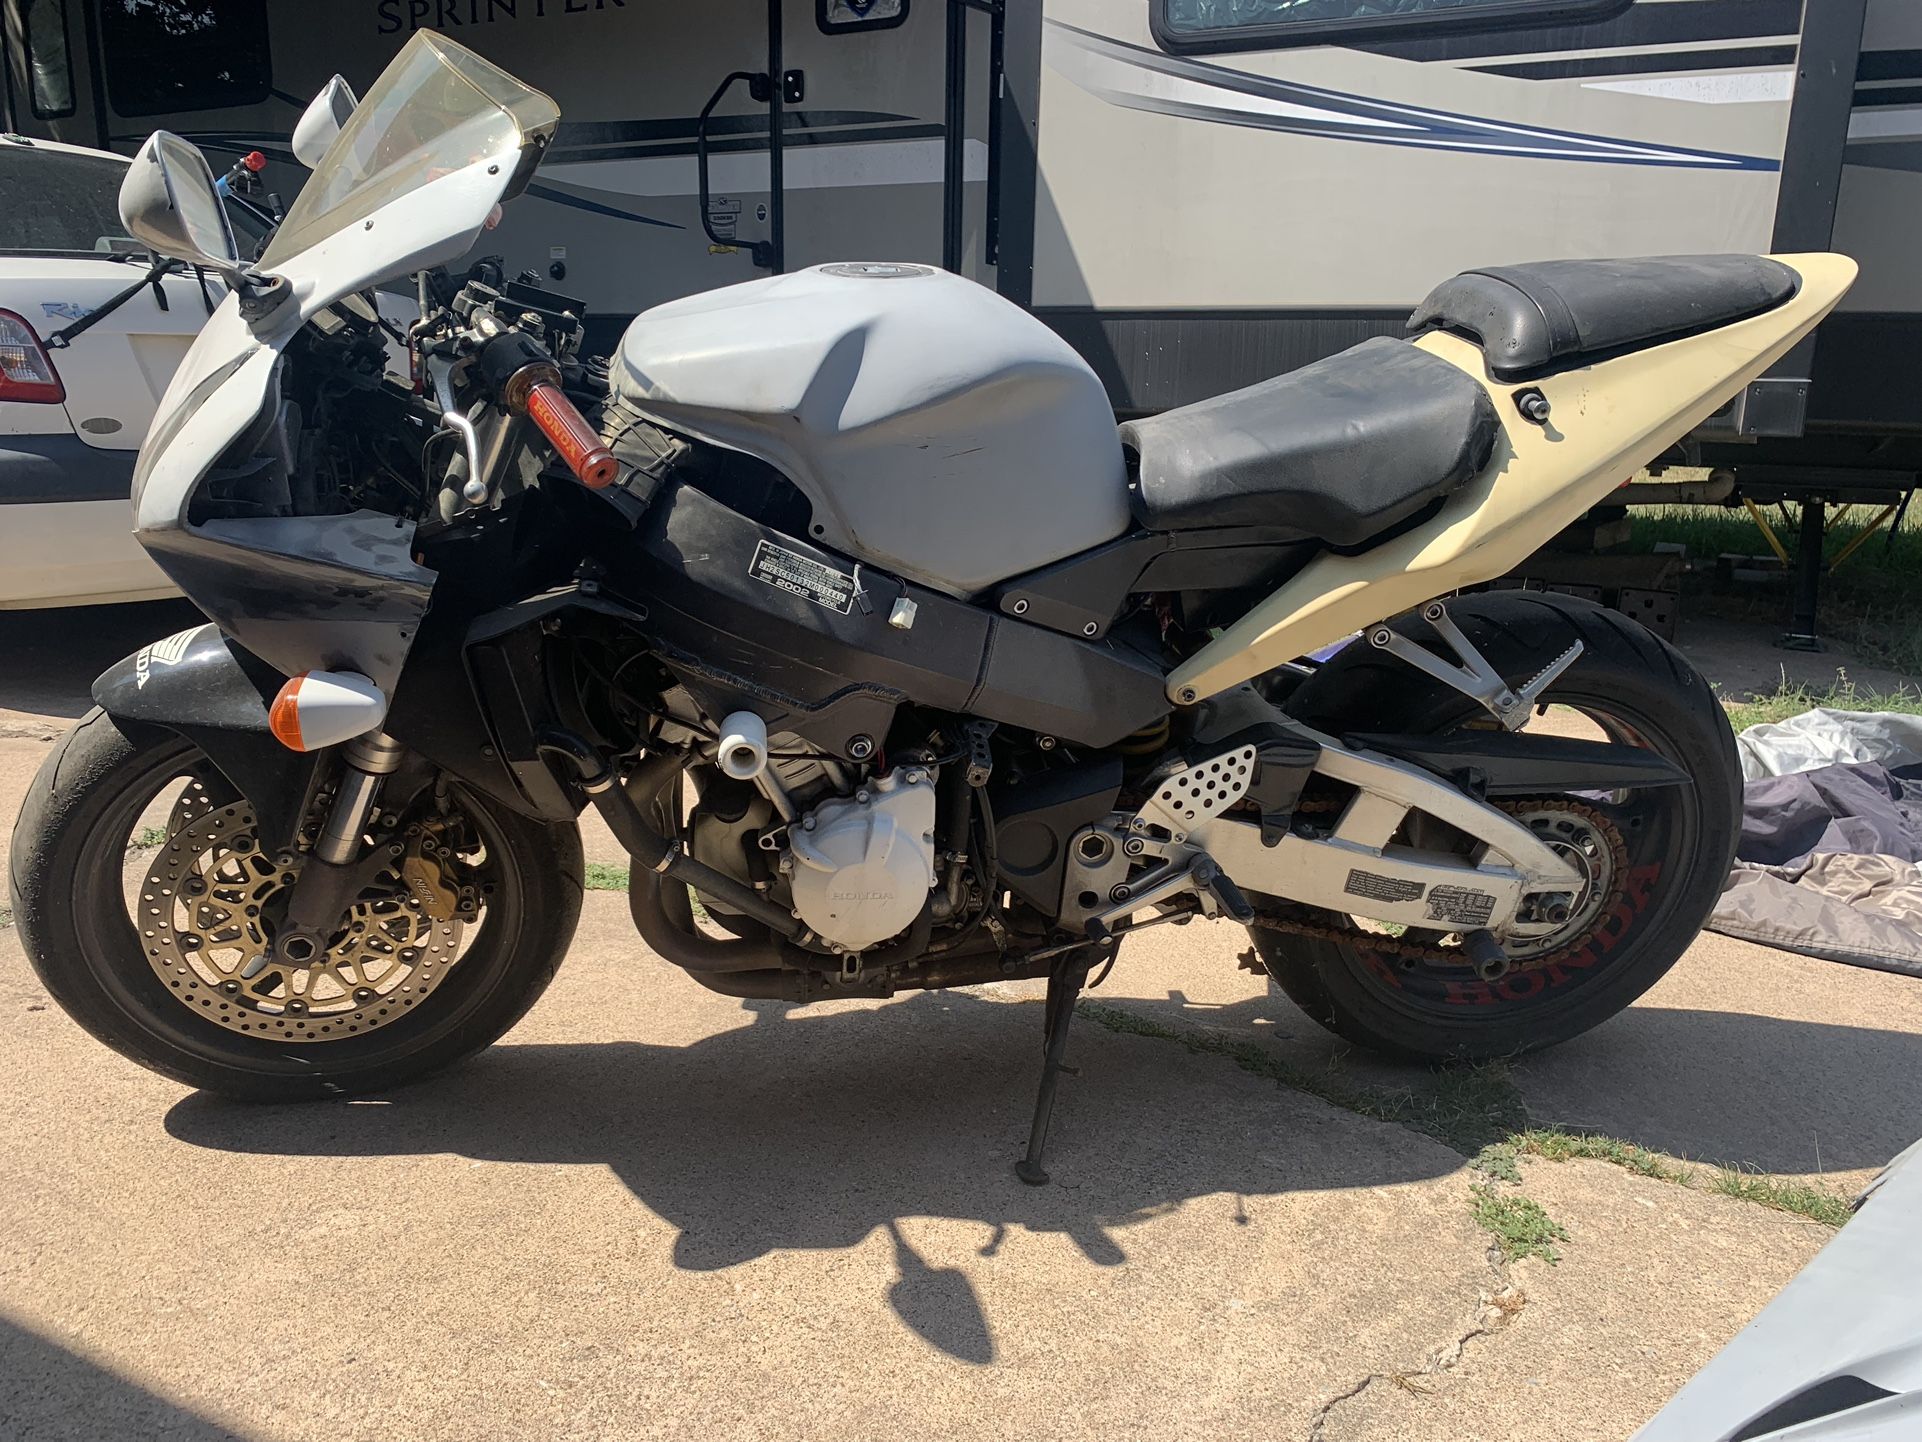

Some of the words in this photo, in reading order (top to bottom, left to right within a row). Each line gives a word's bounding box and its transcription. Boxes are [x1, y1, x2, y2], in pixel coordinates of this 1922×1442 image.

[377, 0, 625, 35] SPRIN
[533, 400, 577, 458] HONDA
[775, 577, 810, 597] 2002
[831, 891, 895, 902] HONDA
[1444, 862, 1661, 1005] HONDA
